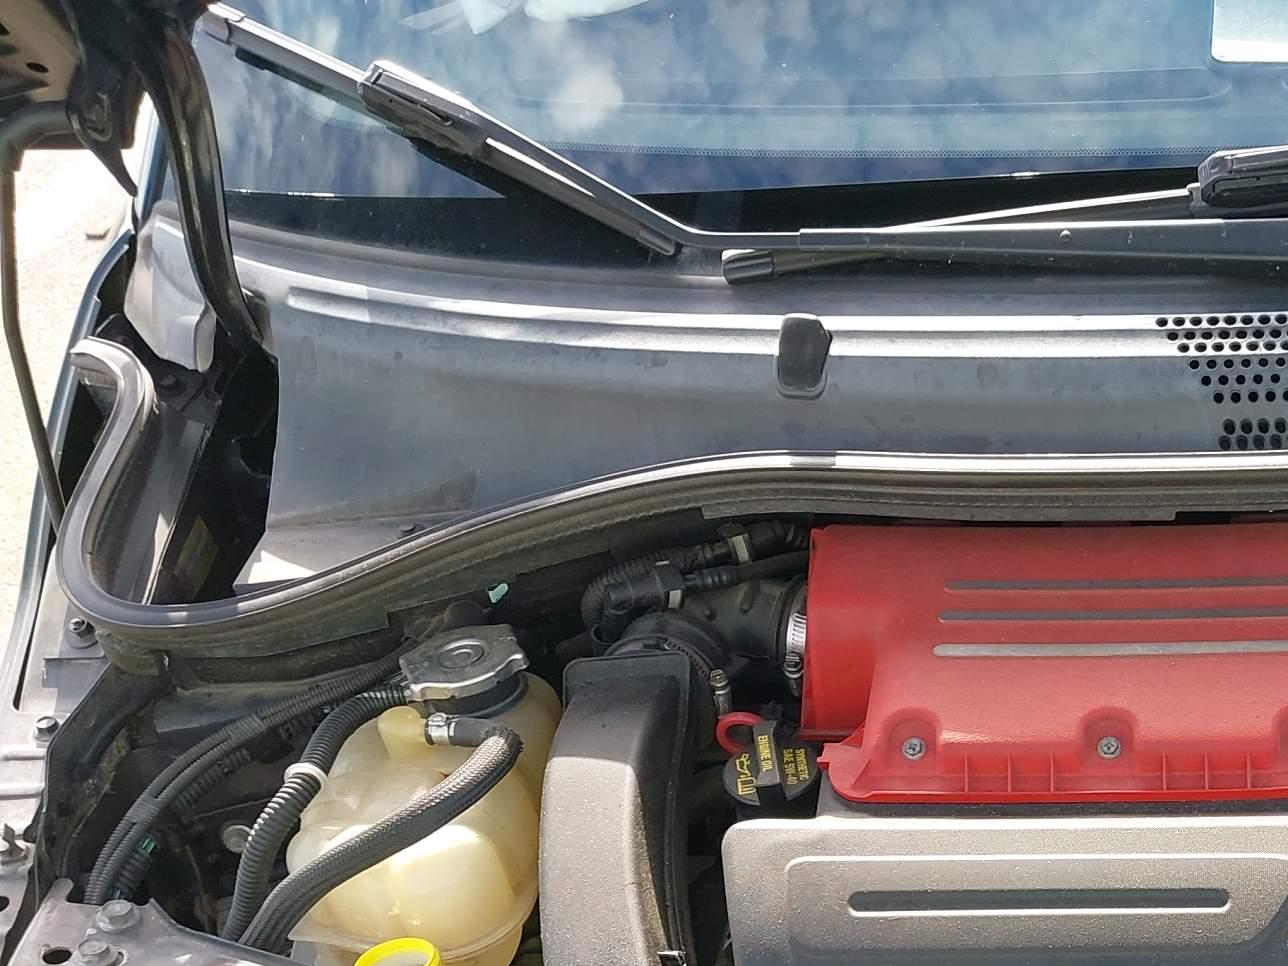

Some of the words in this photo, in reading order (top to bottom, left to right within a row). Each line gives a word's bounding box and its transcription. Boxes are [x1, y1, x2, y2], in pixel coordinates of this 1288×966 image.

[757, 735, 771, 761] ENGINE
[782, 749, 793, 764] SAE
[760, 761, 773, 772] OIL
[784, 764, 798, 785] 5W-40
[795, 748, 809, 781] SYNTHETIC
